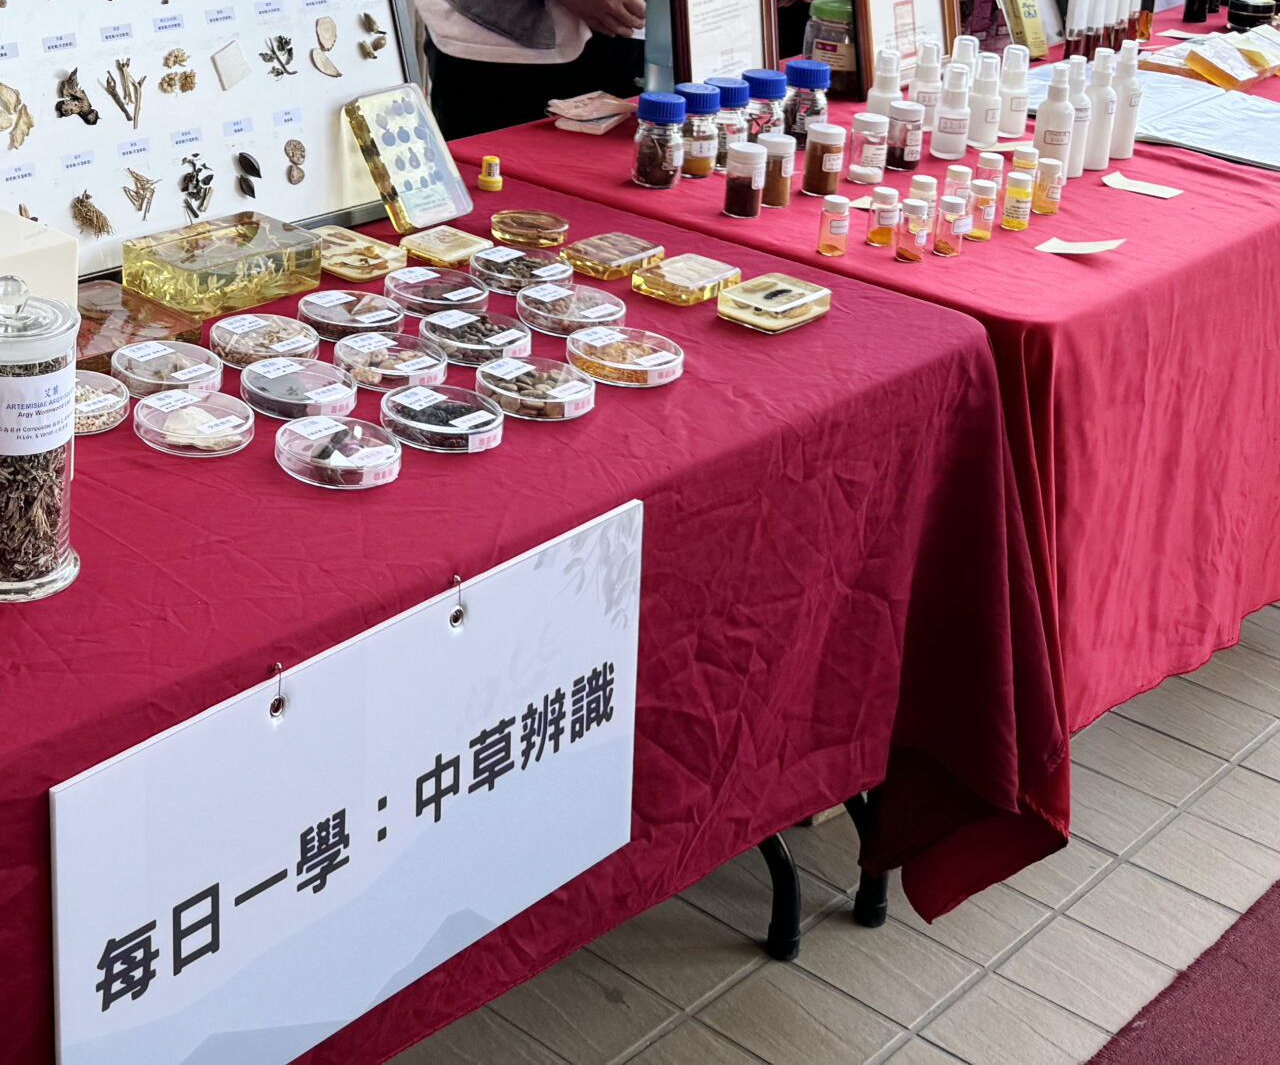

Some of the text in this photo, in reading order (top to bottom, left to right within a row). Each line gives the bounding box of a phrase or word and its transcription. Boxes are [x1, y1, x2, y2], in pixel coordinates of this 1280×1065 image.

[95, 661, 616, 1013] 每日一學：中草辨識
